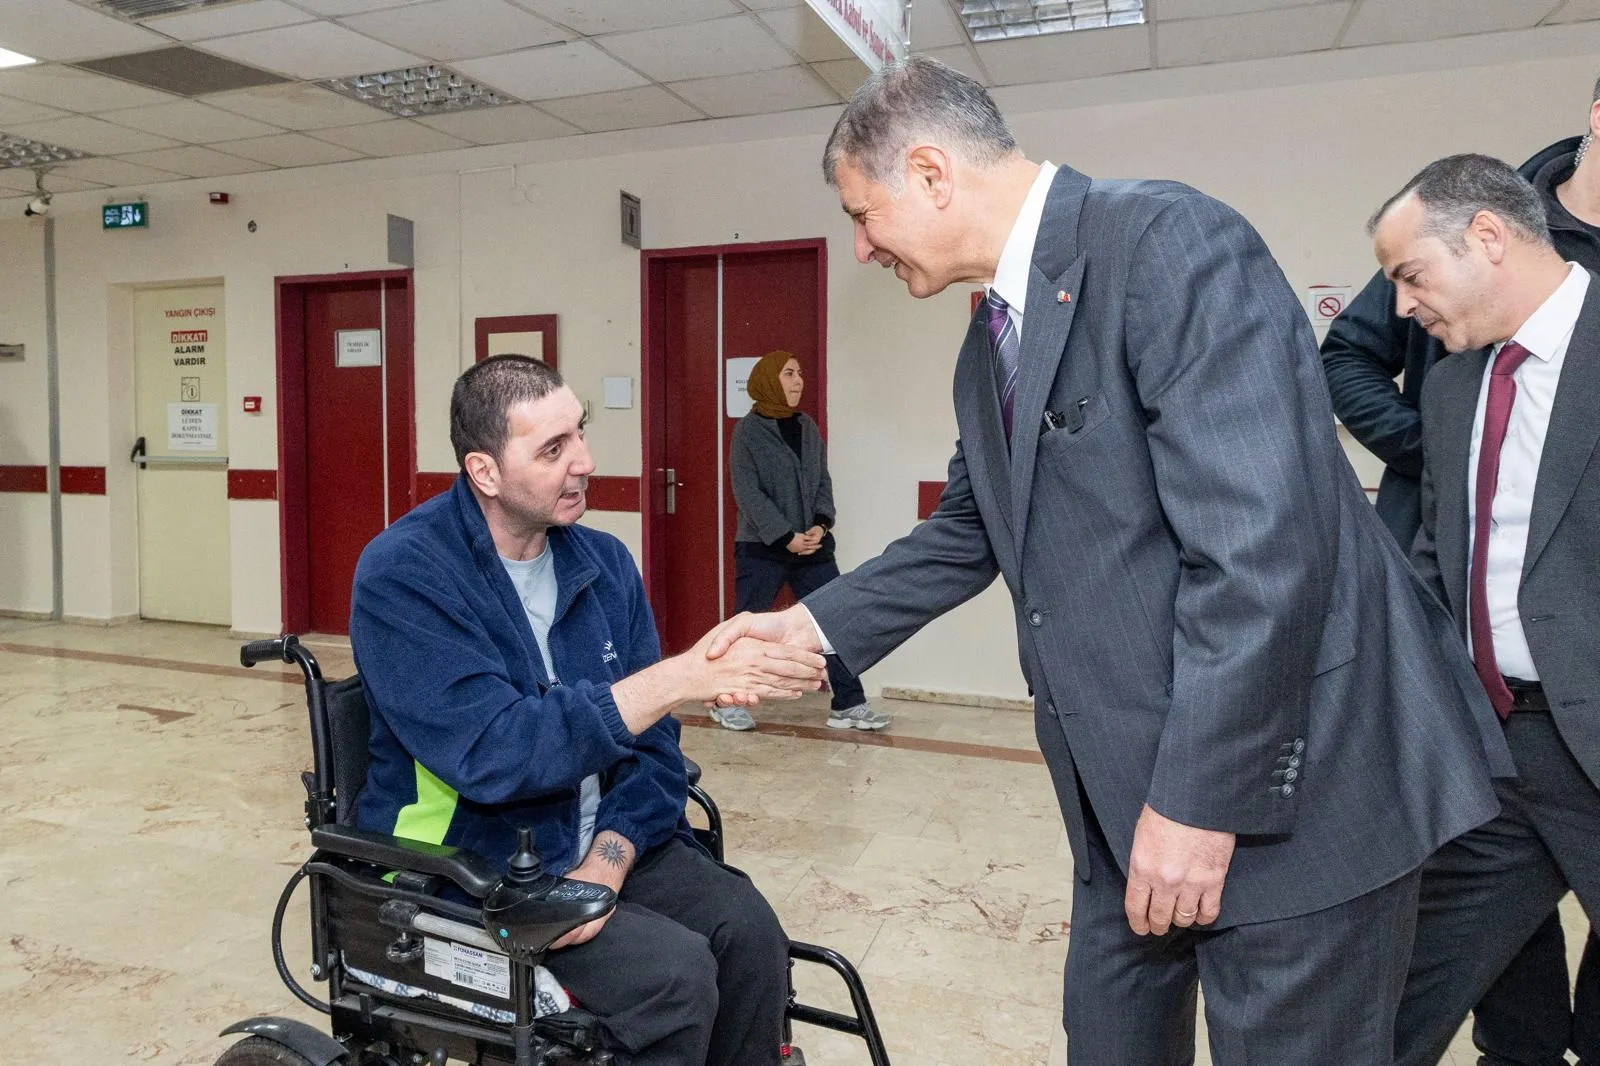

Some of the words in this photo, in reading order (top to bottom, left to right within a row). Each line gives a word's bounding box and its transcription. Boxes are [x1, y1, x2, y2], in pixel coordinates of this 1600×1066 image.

[164, 310, 192, 318] YANGIN
[174, 345, 205, 354] ALARM
[173, 357, 206, 366] VARDIR
